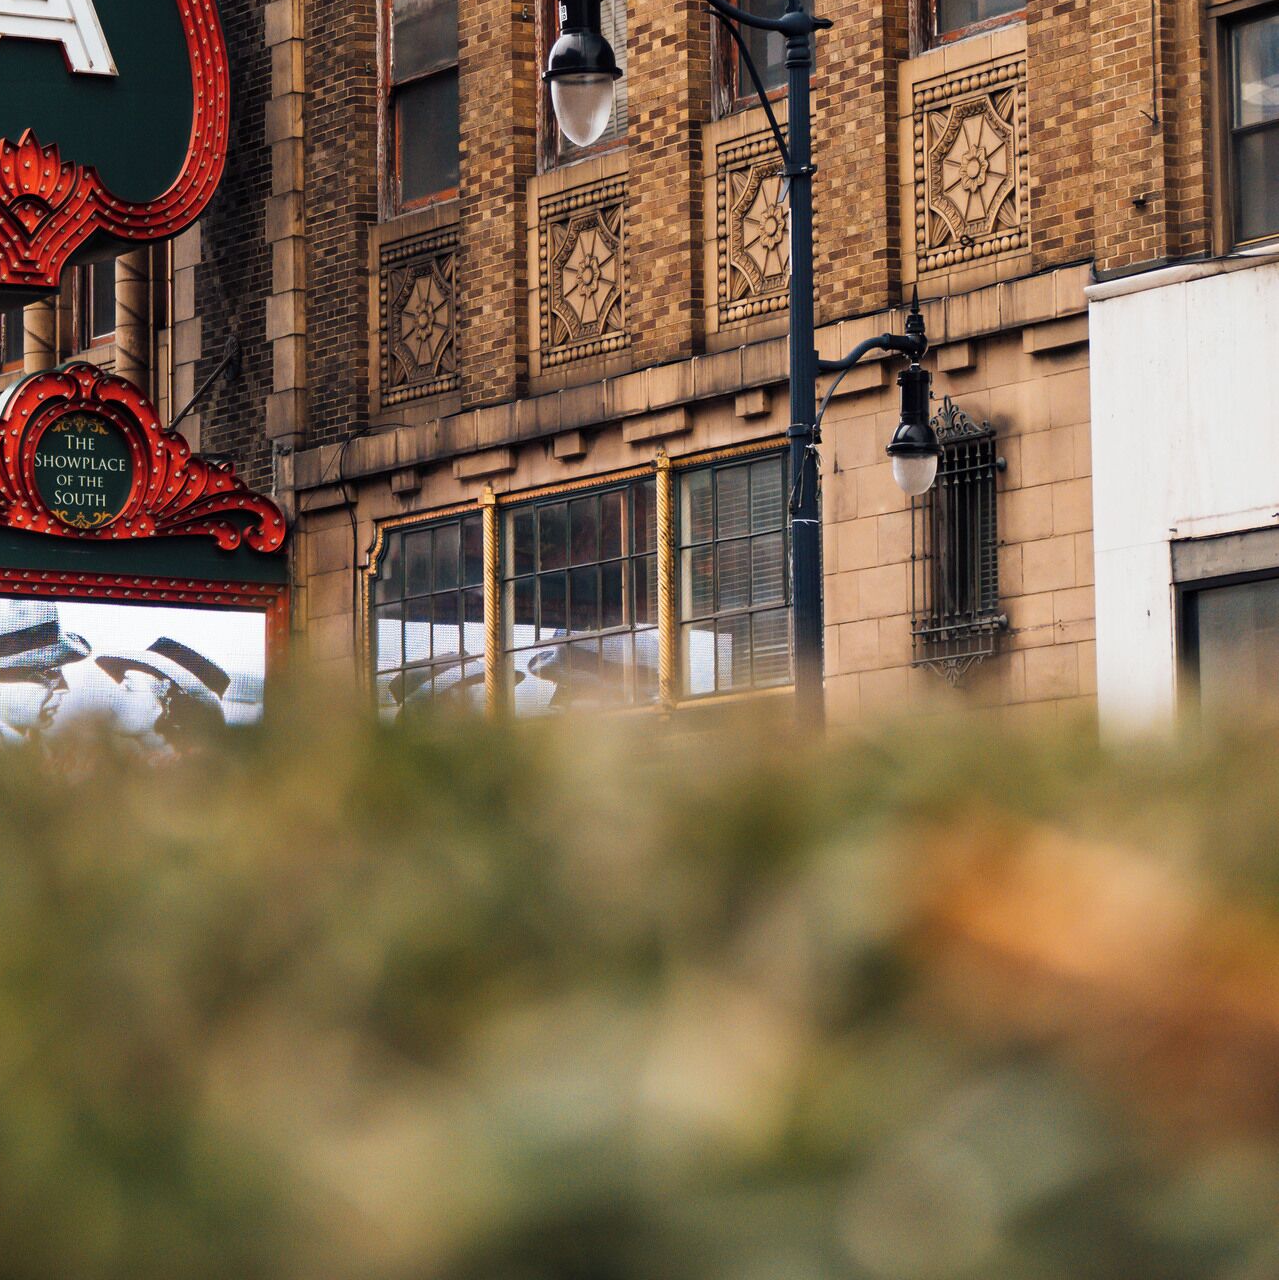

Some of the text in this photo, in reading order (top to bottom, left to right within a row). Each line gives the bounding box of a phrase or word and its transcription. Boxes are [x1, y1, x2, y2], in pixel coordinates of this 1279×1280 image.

[64, 434, 95, 451] THE
[34, 452, 126, 472] SHOWPLACE
[56, 474, 104, 488] OF THE
[54, 490, 107, 507] SOUTH
